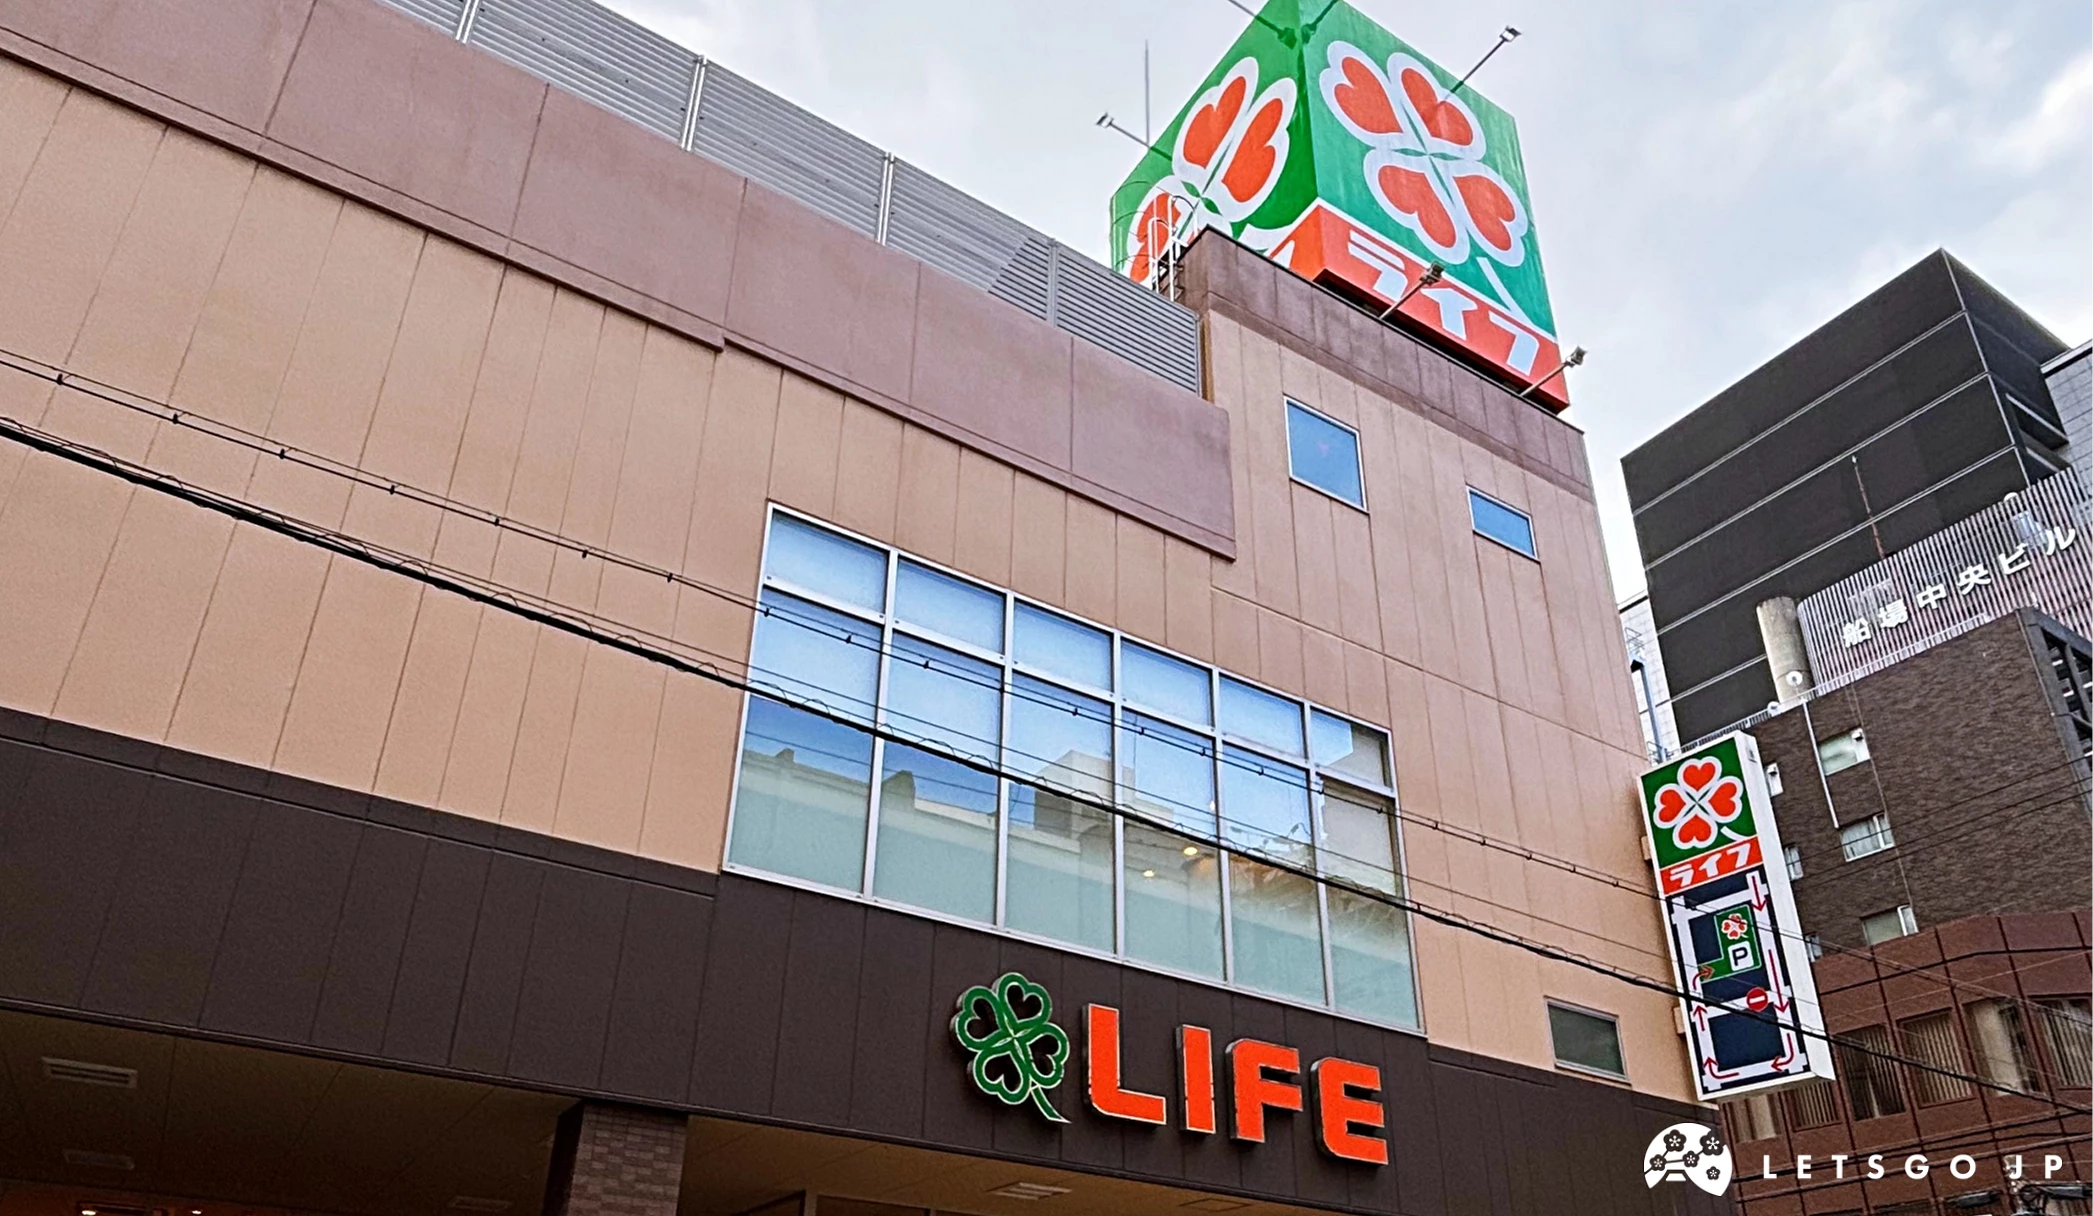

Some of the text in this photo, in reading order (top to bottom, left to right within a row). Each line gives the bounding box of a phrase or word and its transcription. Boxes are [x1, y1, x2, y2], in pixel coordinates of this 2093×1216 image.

[1349, 231, 1539, 375] ライフ
[1842, 526, 2076, 647] 船場中央ビル
[1670, 843, 1751, 888] ライフ
[1732, 947, 1748, 966] P
[1084, 1003, 1389, 1165] LIFE
